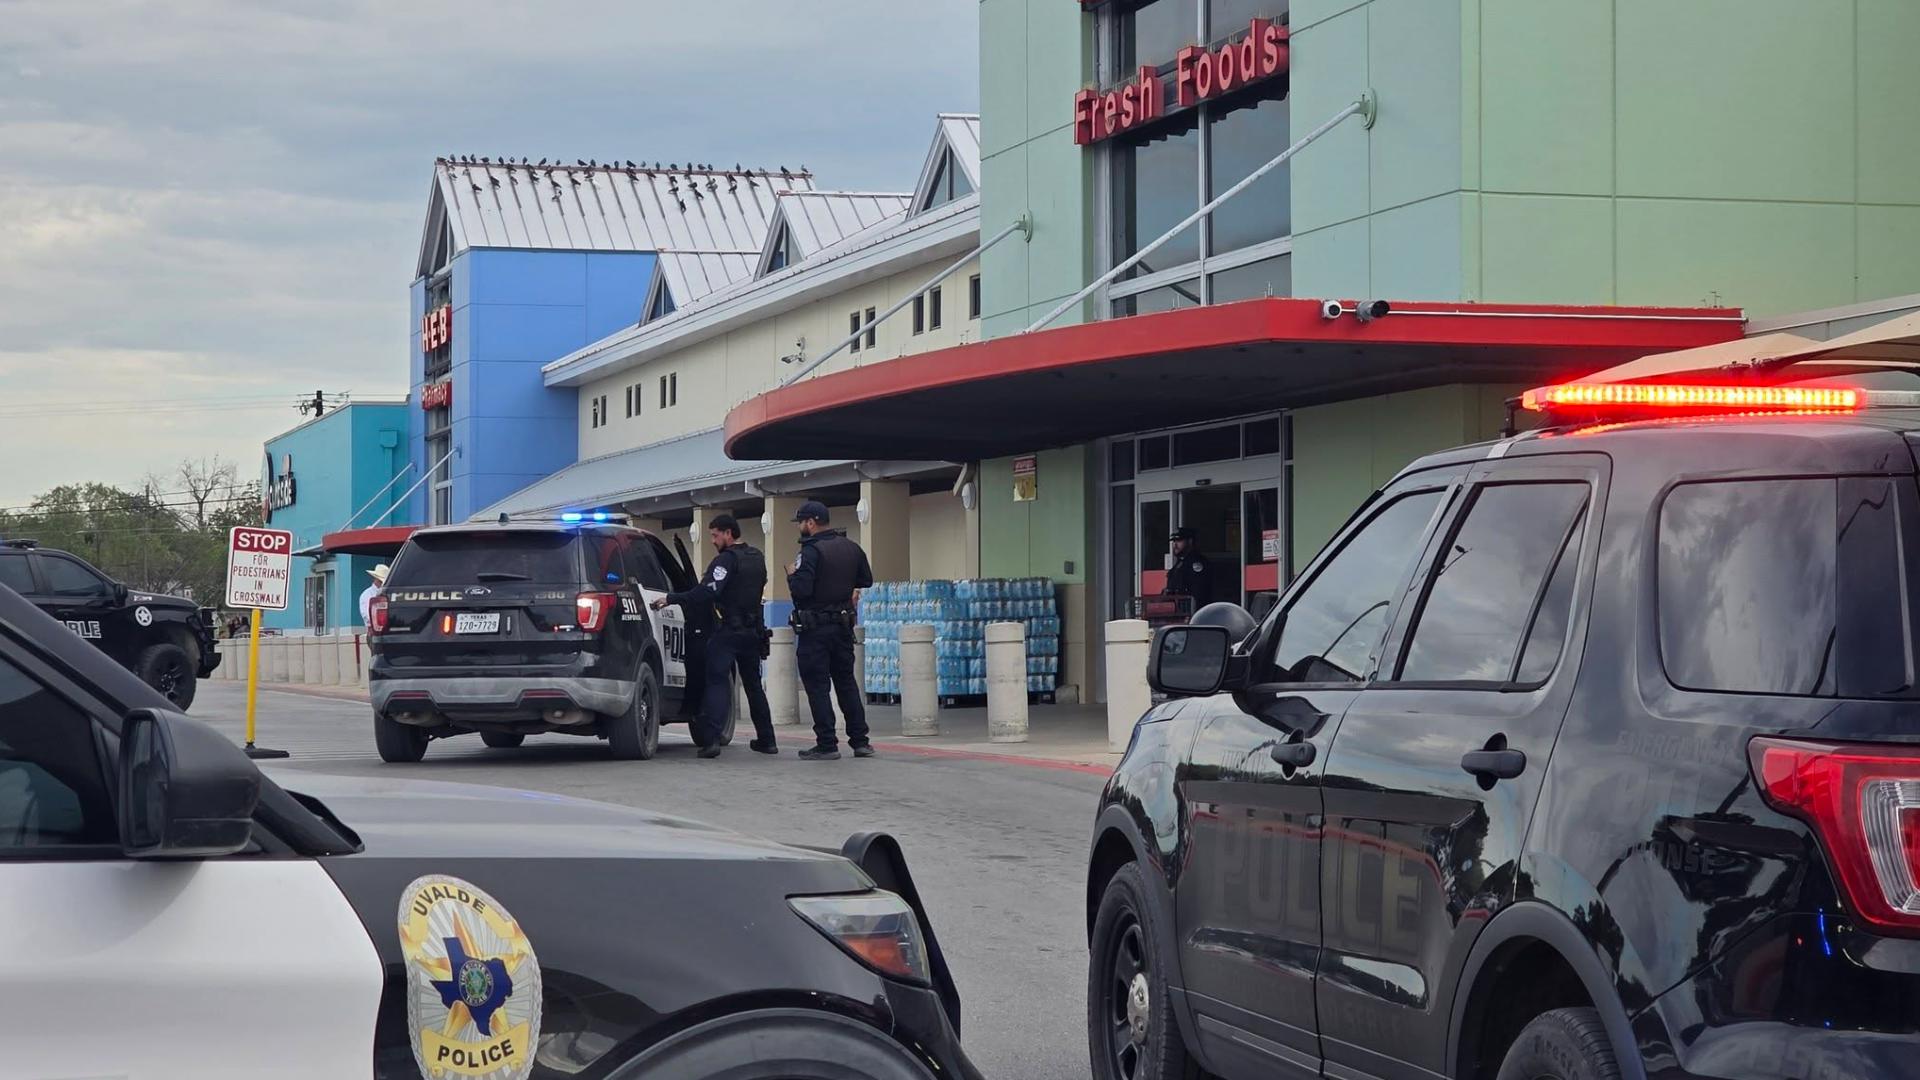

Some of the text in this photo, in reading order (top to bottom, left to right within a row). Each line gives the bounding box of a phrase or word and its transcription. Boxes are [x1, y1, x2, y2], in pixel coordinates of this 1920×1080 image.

[1074, 18, 1287, 144] Fresh Foods
[237, 531, 287, 550] STOP
[252, 554, 268, 566] FOR
[233, 565, 286, 580] PEDESTRIANS
[254, 580, 263, 590] IN
[234, 591, 281, 604] CROSSWALK
[621, 598, 638, 614] 911
[1204, 822, 1422, 955] POLICE
[413, 885, 486, 916] UVALDE
[437, 1039, 514, 1068] POLICE
